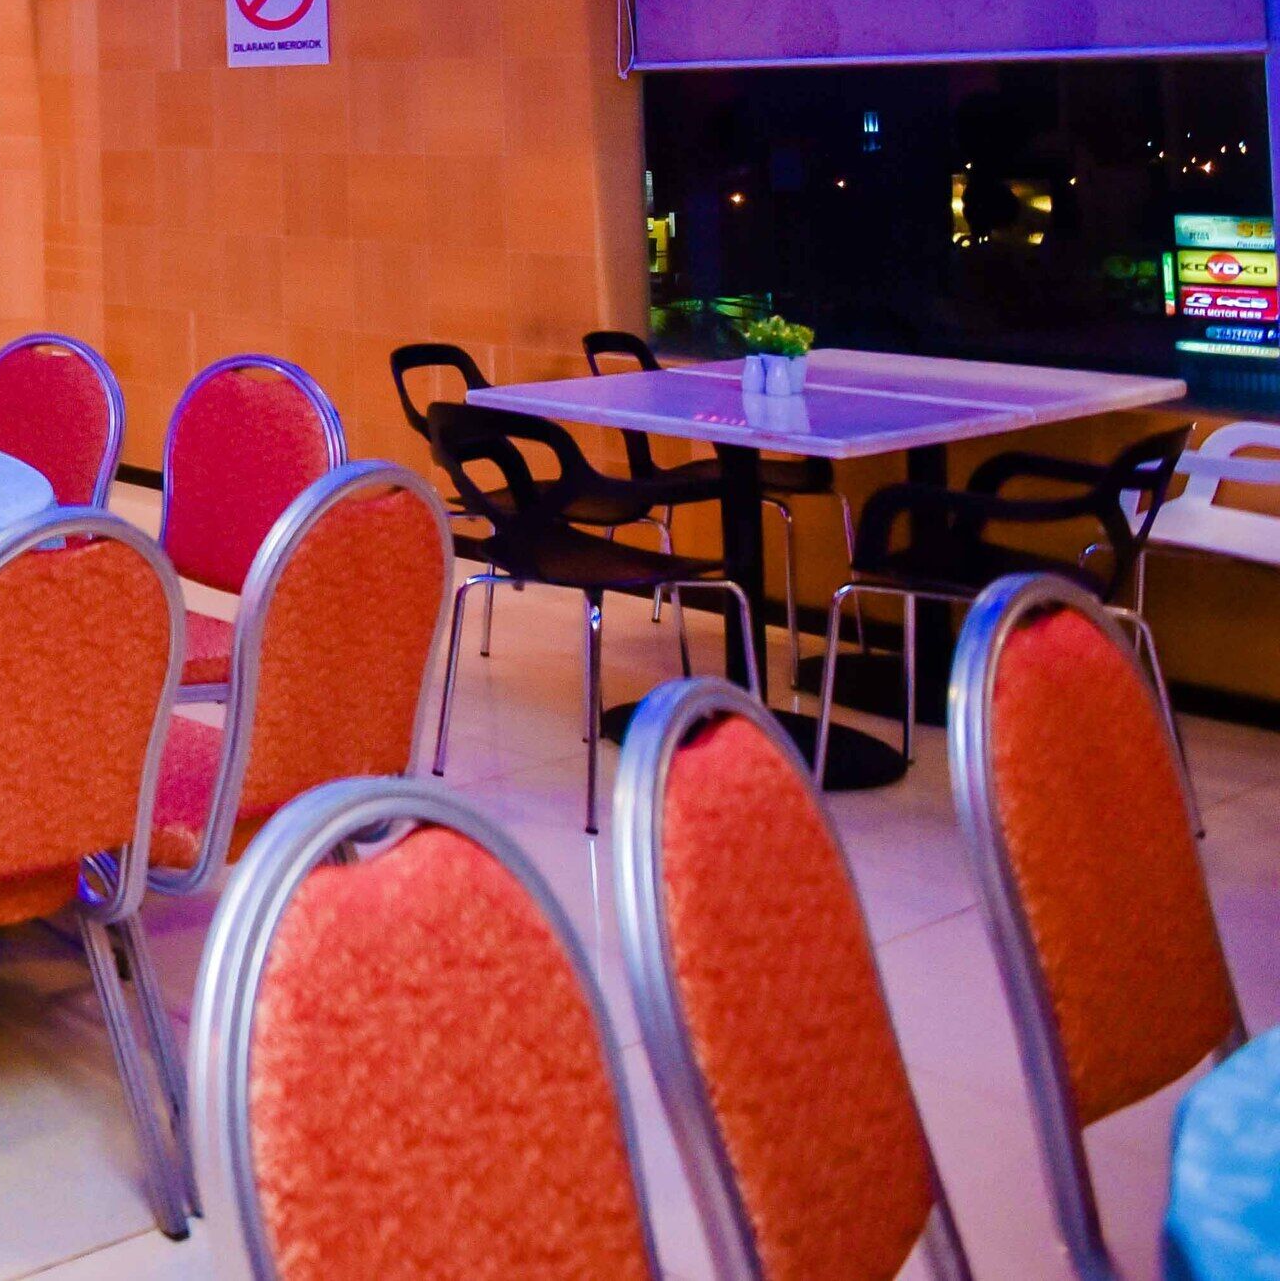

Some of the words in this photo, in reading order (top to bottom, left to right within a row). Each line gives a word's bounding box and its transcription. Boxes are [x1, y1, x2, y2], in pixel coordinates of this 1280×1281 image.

[234, 42, 276, 53] DILARANG
[277, 40, 322, 51] MEROKOK
[1181, 261, 1268, 275] KOYOKO
[1207, 308, 1238, 318] MOTOR
